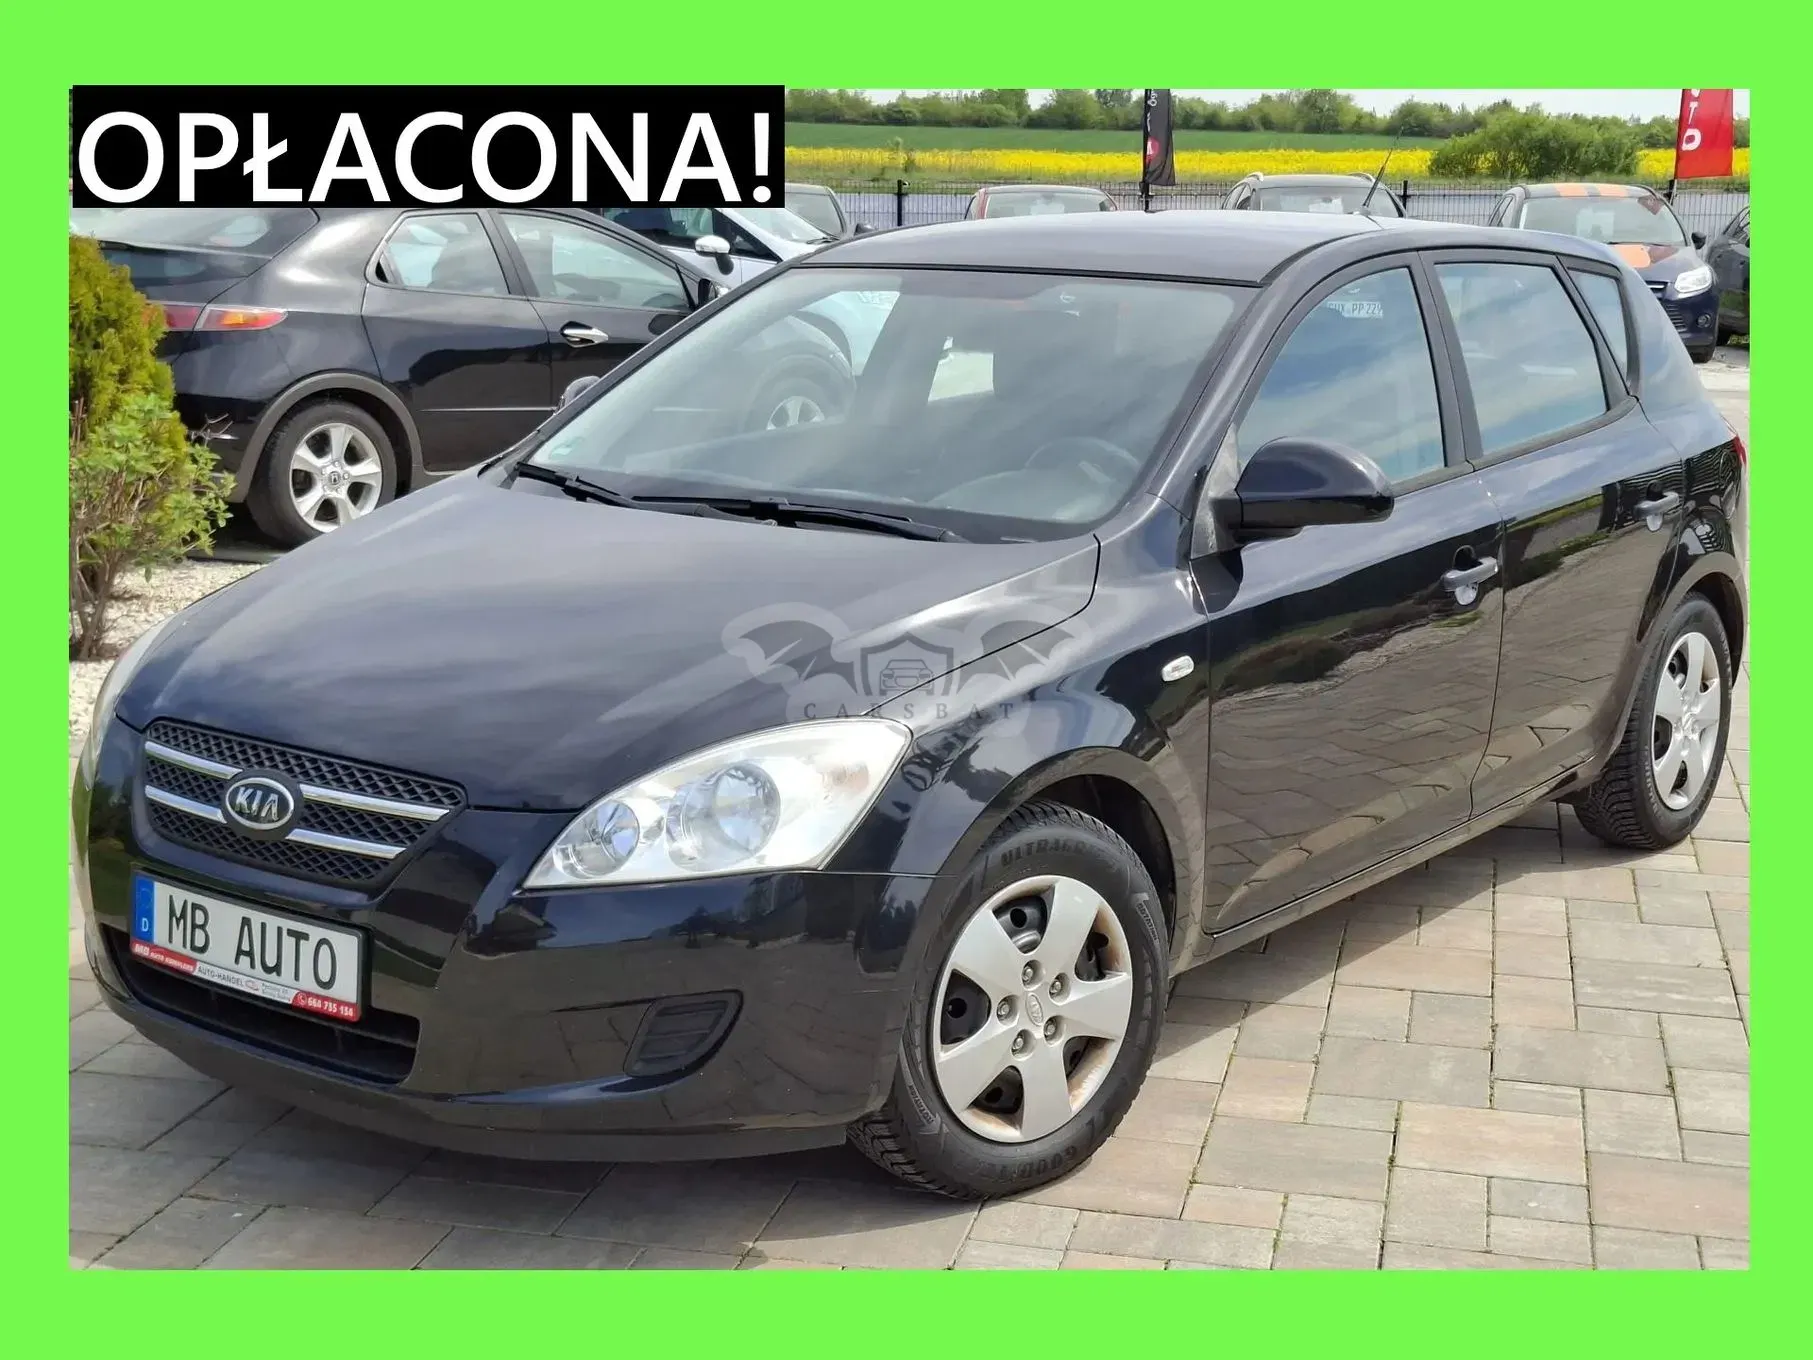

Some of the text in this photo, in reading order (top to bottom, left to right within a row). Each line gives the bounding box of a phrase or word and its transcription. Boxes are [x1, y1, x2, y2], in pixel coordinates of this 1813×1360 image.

[234, 785, 280, 821] KIA
[141, 917, 149, 932] D
[168, 894, 338, 991] MB AUTO
[197, 966, 244, 987] AUTO-HANDEL
